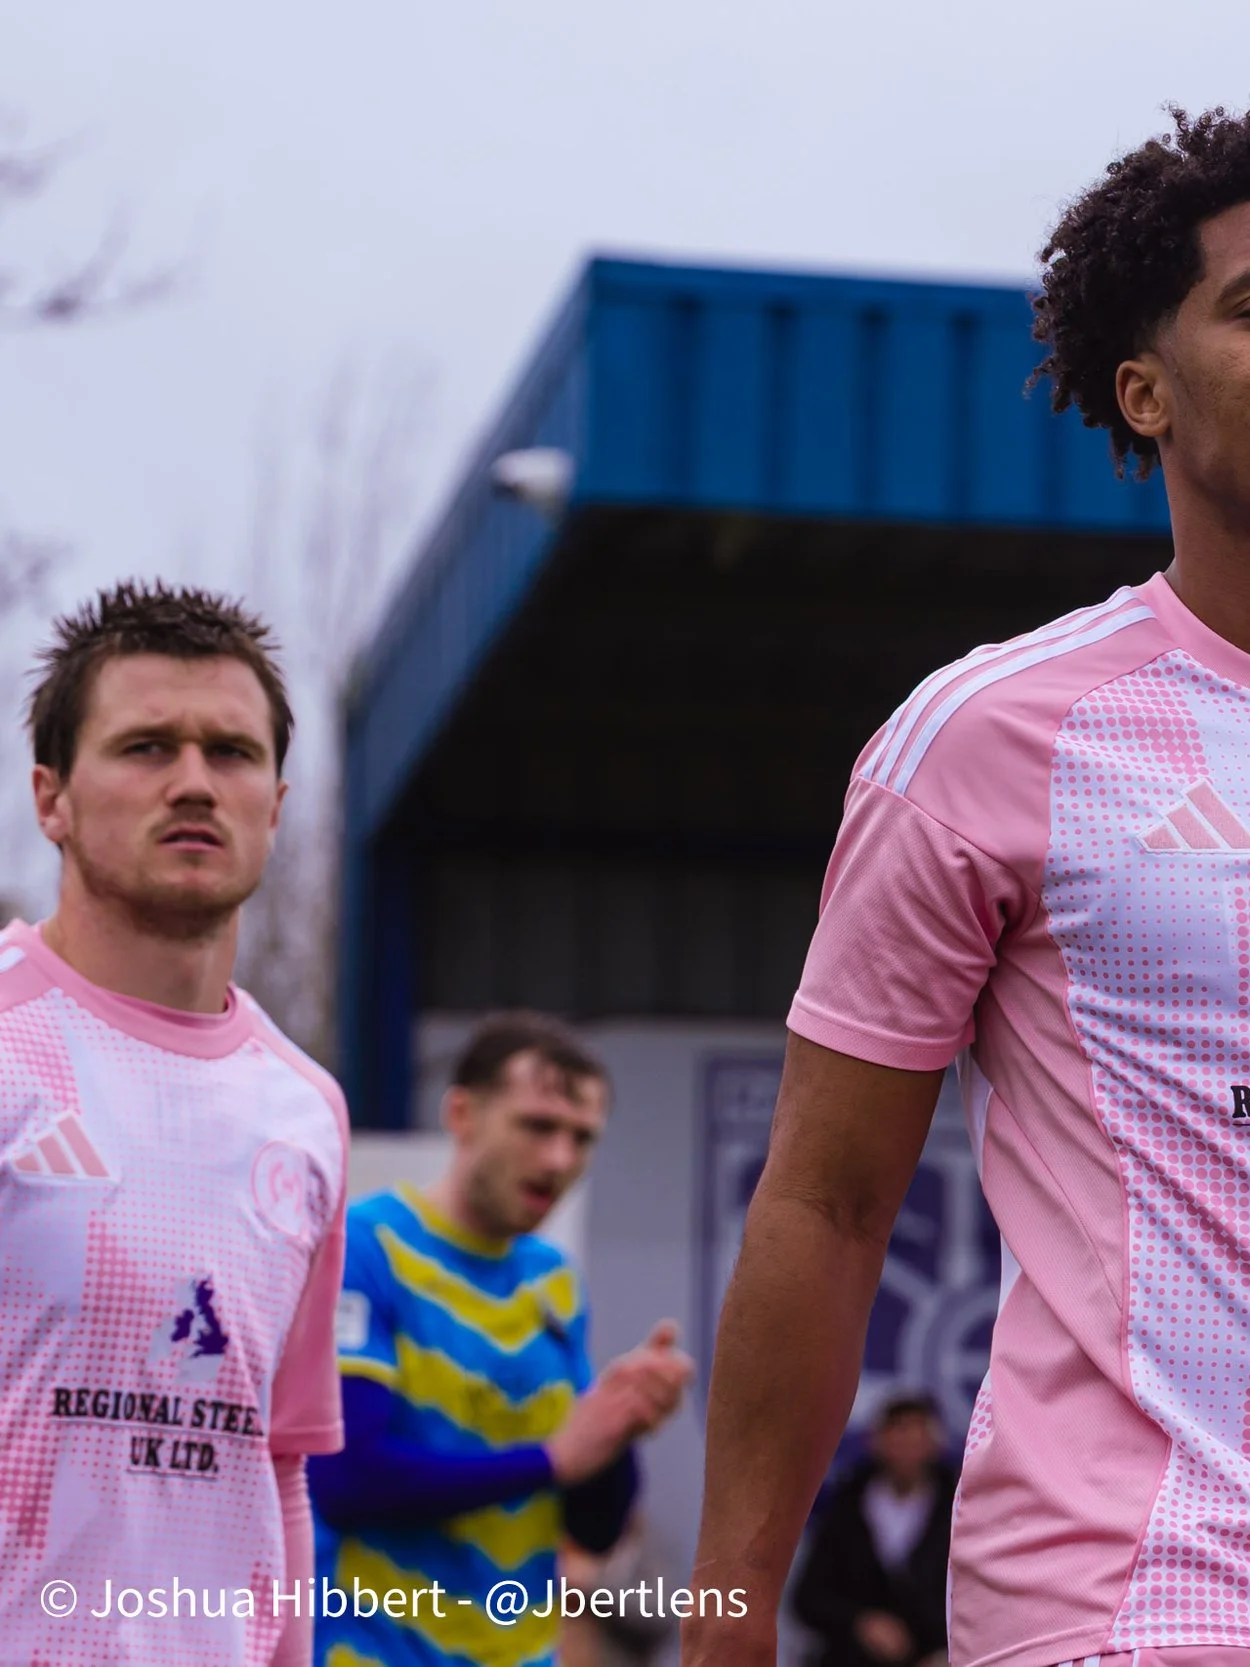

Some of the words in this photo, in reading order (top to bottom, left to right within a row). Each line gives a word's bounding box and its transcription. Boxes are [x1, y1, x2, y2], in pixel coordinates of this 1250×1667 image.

[53, 1388, 183, 1426] REGIONAL
[130, 1436, 165, 1467] UK
[169, 1441, 219, 1473] LTD.
